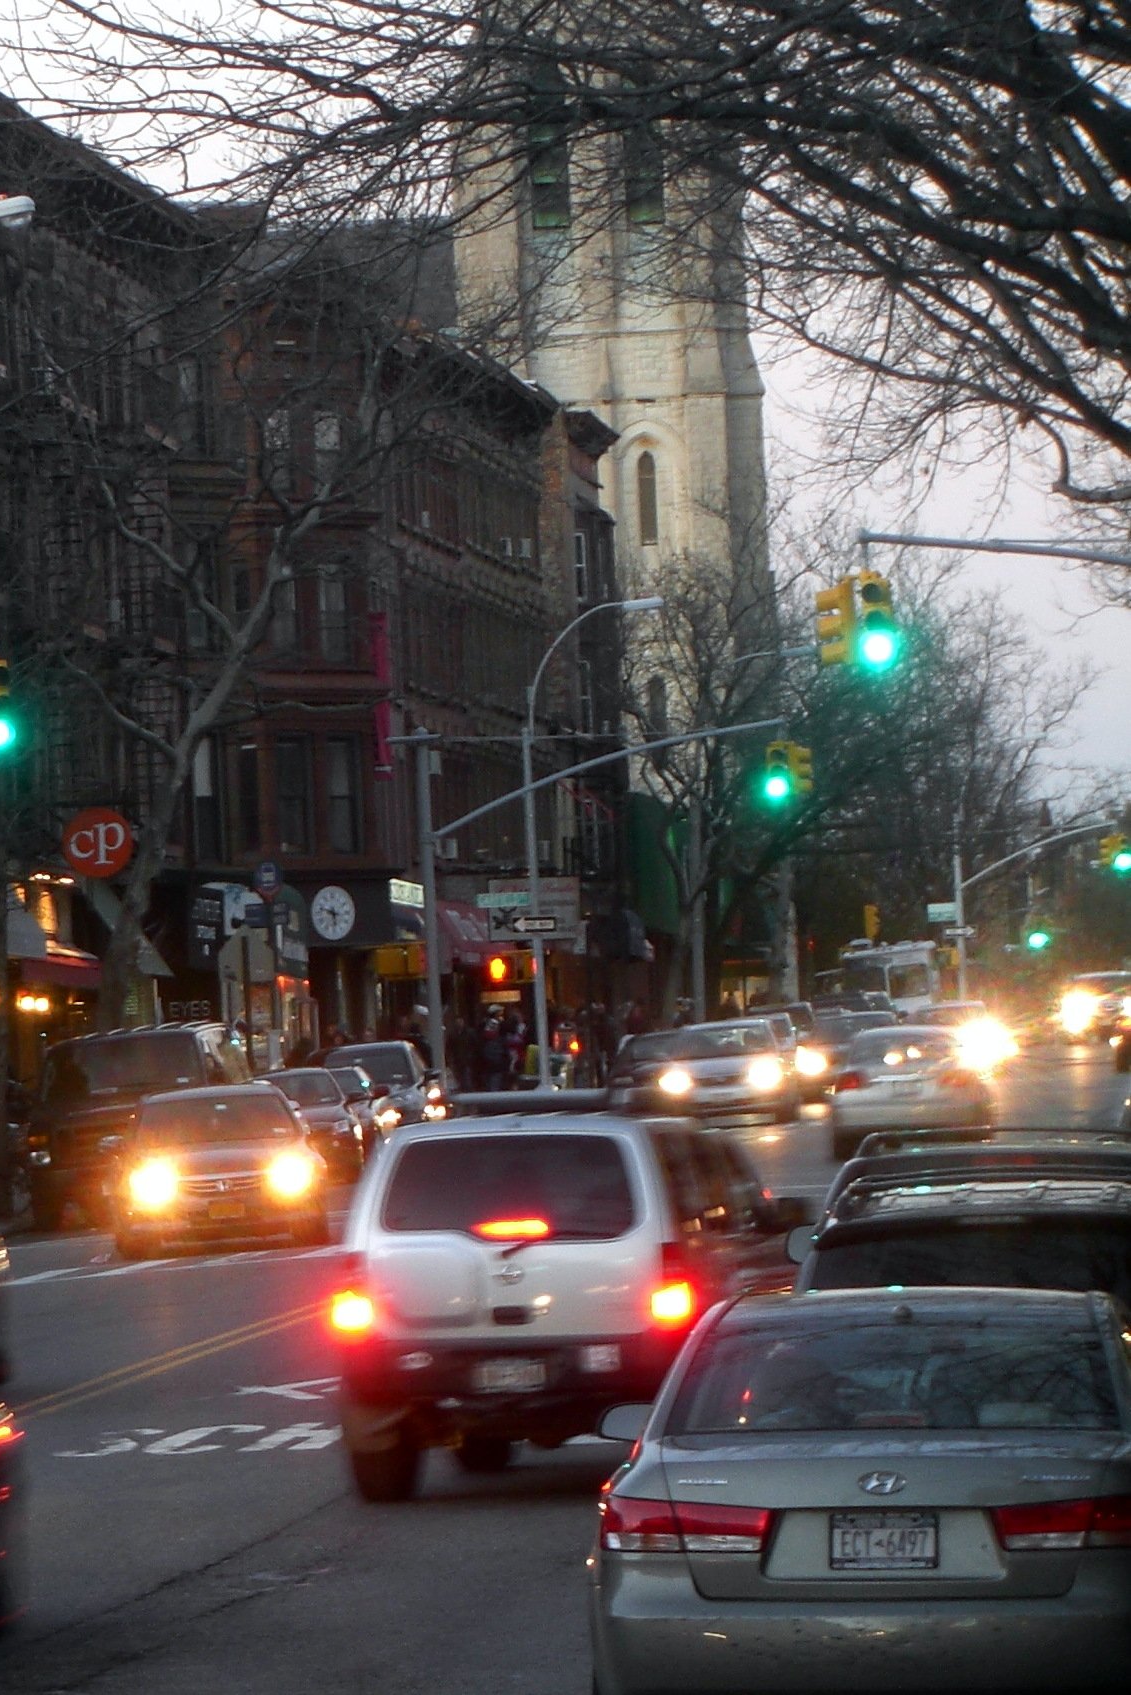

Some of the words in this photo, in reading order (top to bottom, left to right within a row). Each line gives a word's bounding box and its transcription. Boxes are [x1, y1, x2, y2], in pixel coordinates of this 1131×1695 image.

[70, 822, 124, 864] cp
[841, 1530, 871, 1556] ECT
[886, 1529, 928, 1556] 6497
